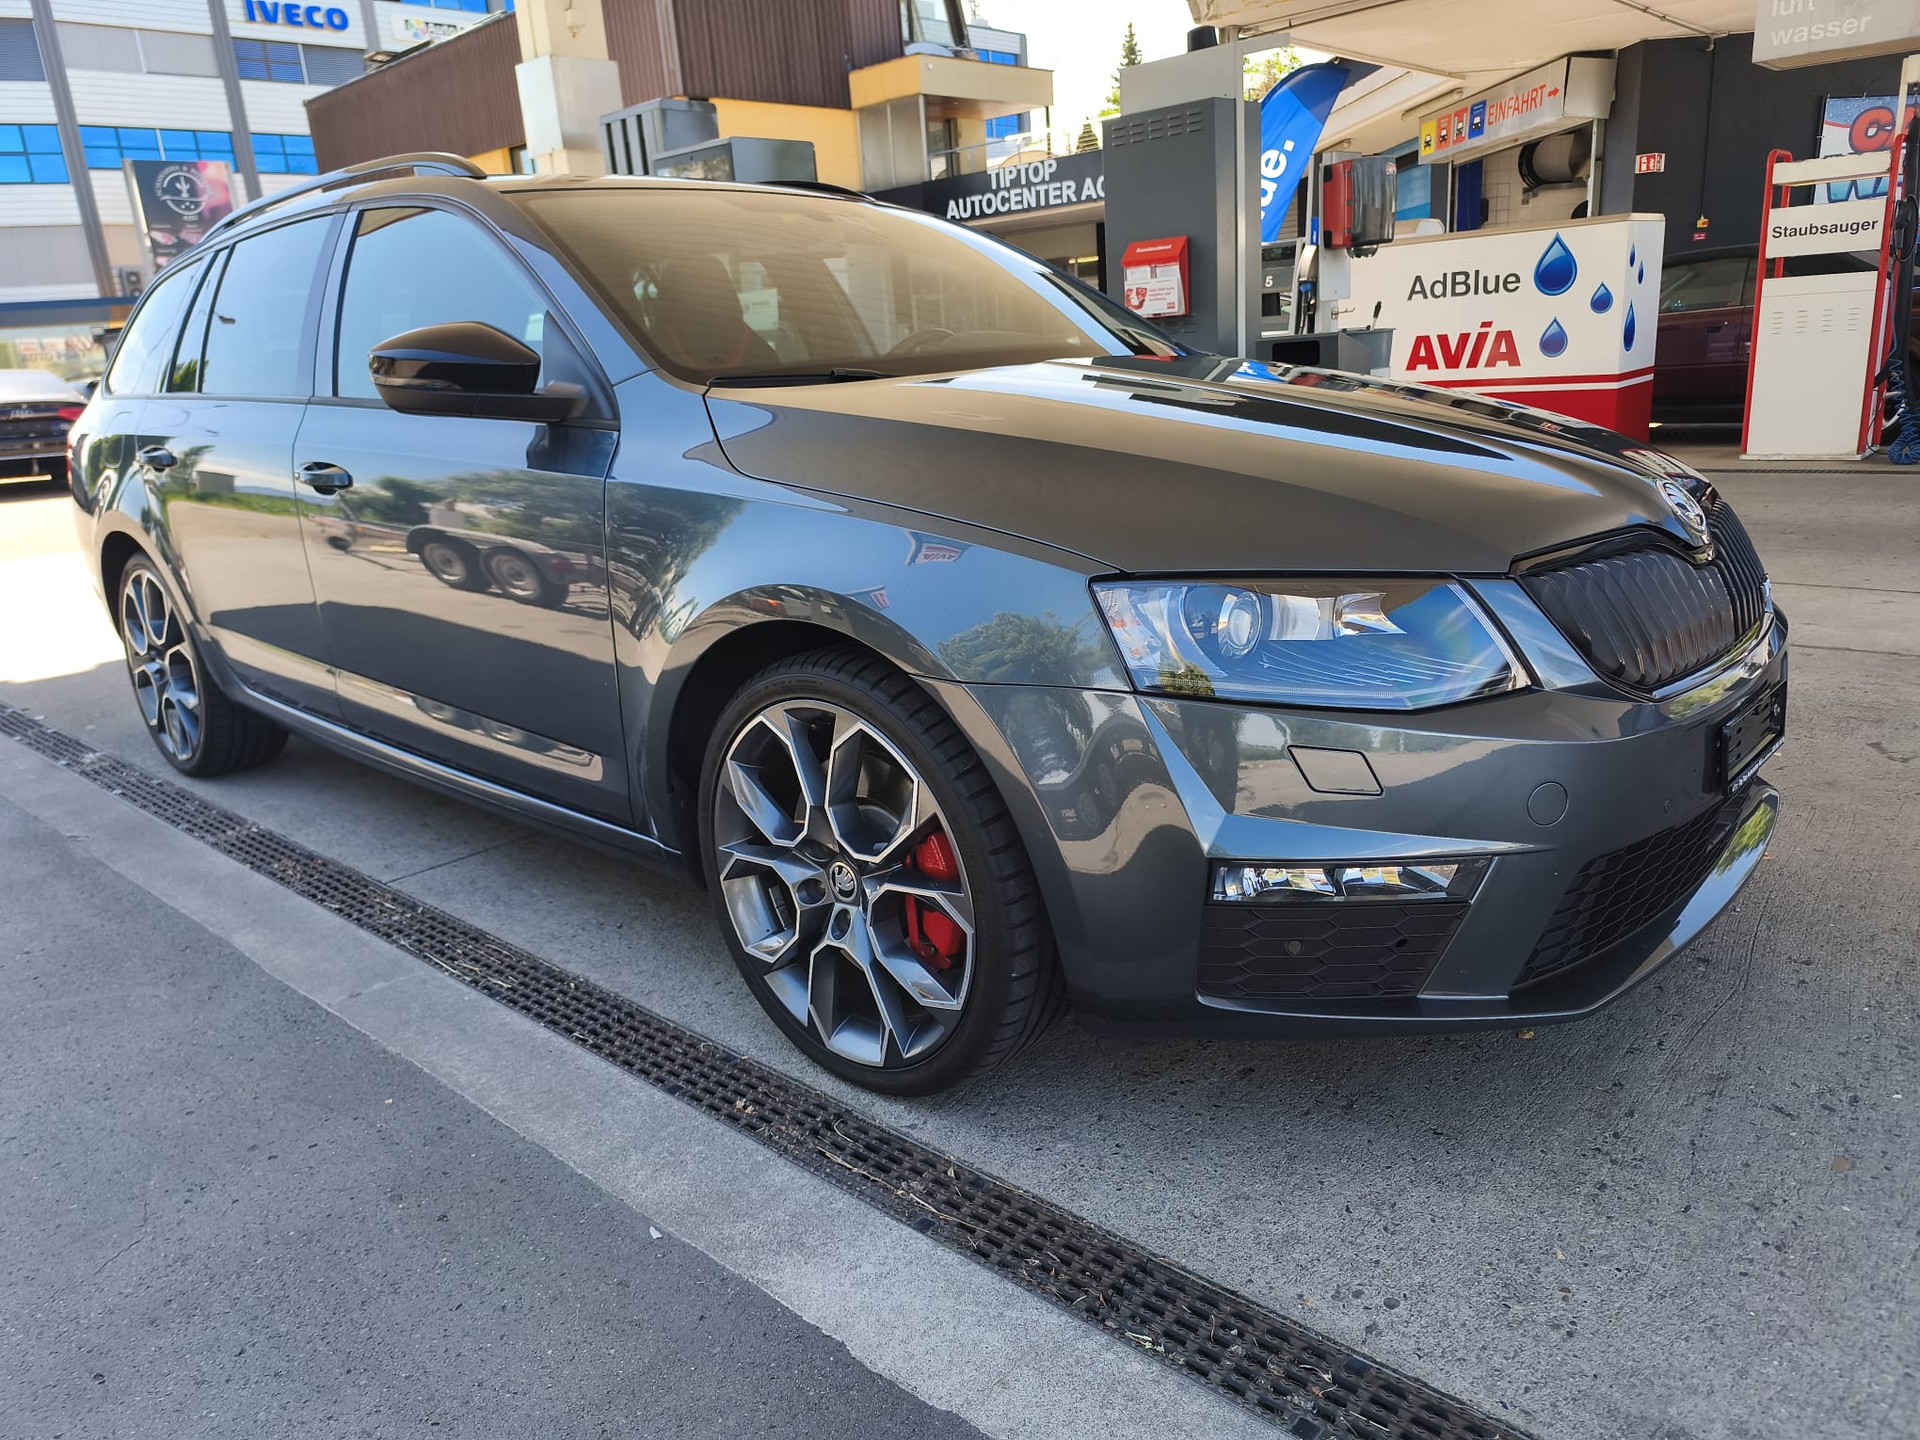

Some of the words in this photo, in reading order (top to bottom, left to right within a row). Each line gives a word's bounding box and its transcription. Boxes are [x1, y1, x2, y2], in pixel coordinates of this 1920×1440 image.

[244, 0, 349, 31] IVECO
[1770, 14, 1872, 47] wasser
[1487, 84, 1547, 126] EINFAHRT
[987, 160, 1058, 190] TIPTOP
[946, 180, 1078, 220] AUTOCENTER
[1771, 218, 1879, 240] Staubsauger
[1264, 275, 1274, 288] 5
[1407, 269, 1521, 301] AdBlue
